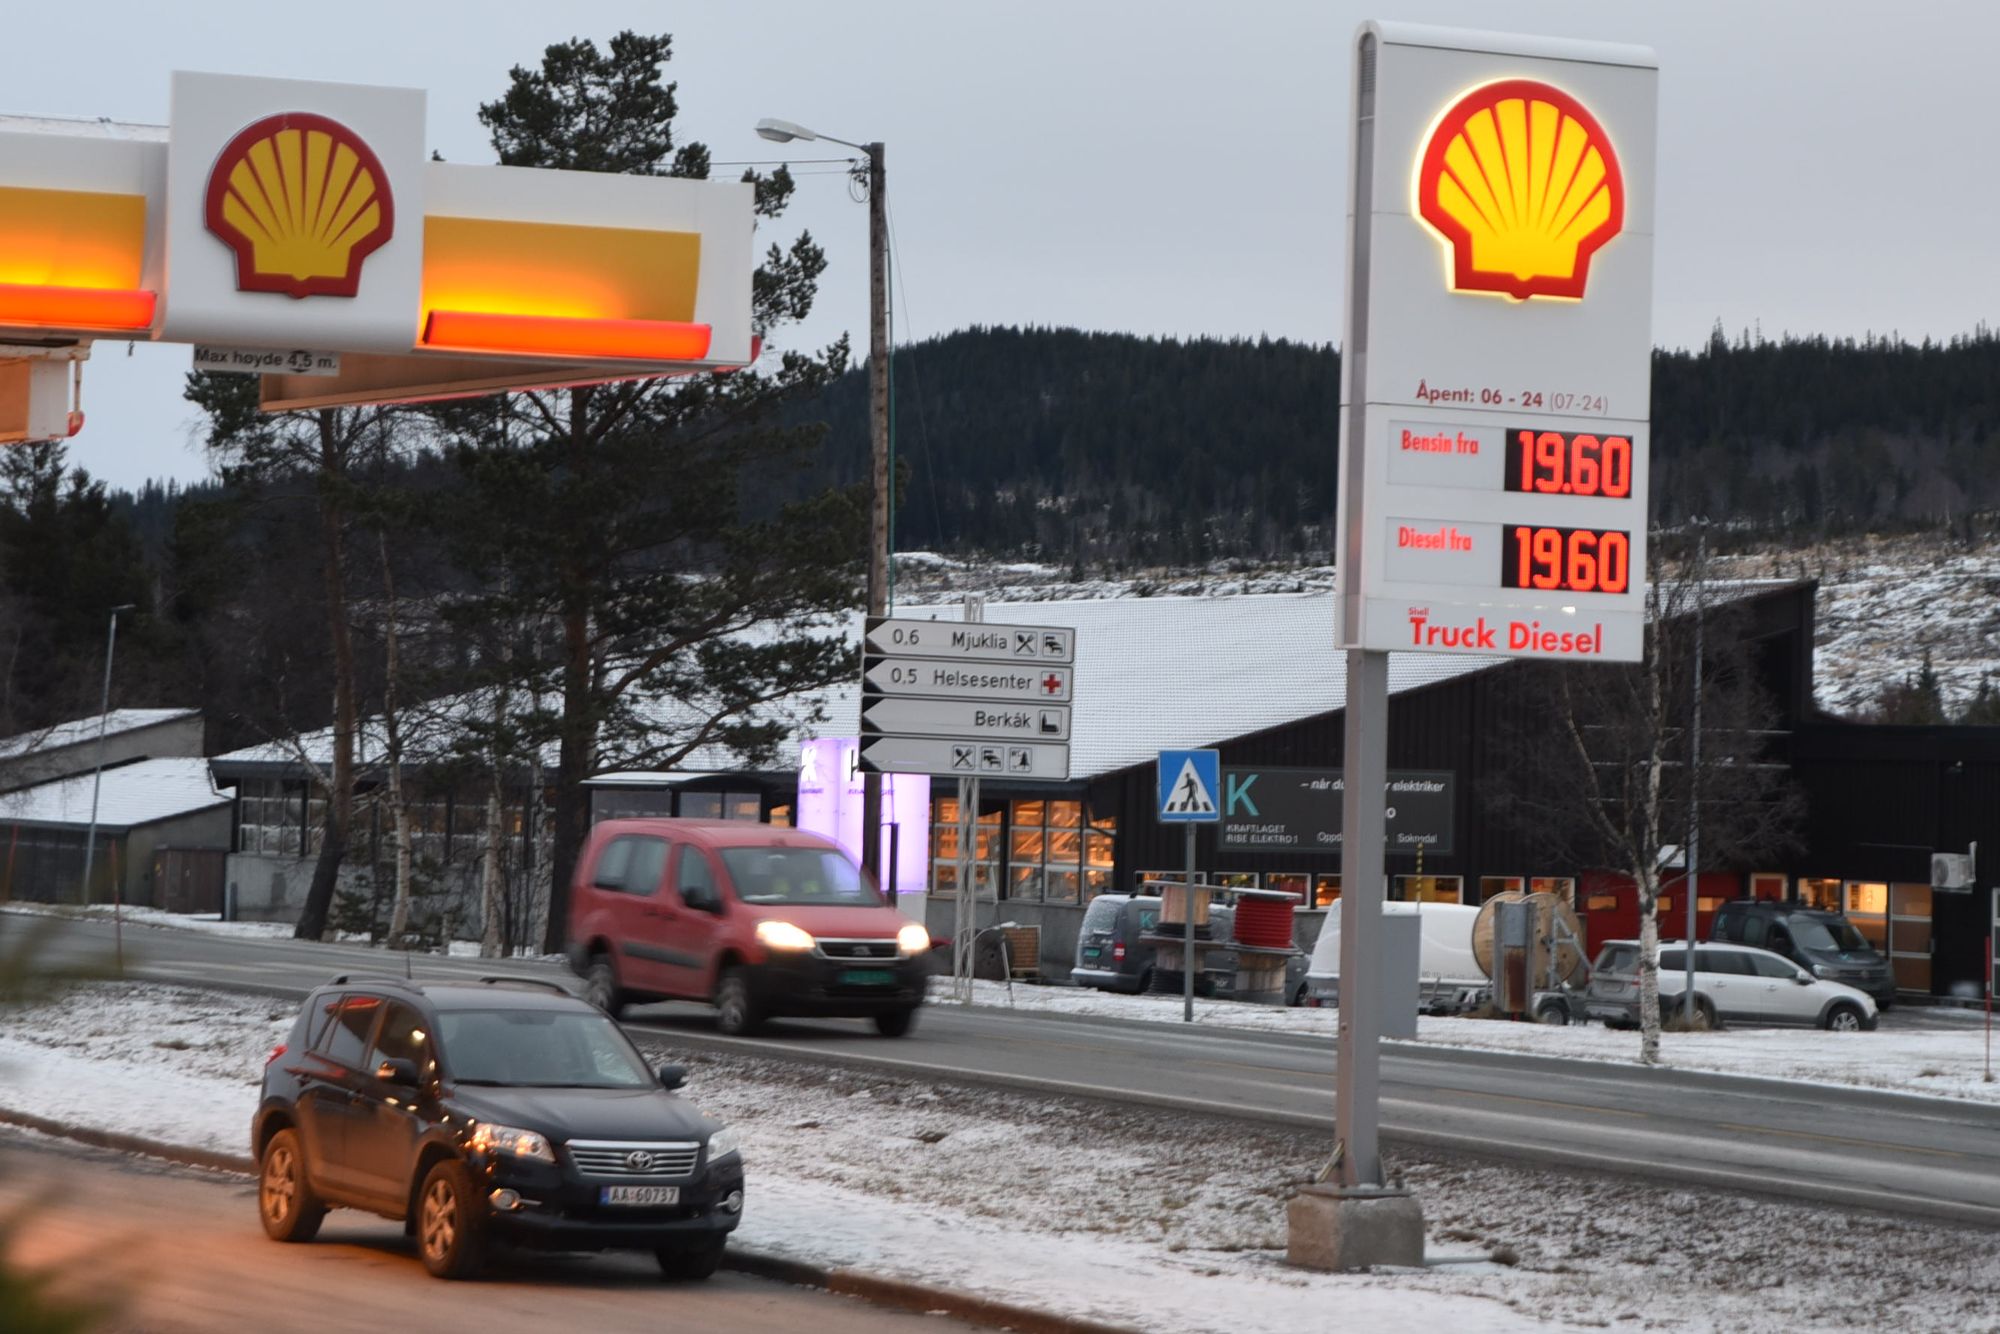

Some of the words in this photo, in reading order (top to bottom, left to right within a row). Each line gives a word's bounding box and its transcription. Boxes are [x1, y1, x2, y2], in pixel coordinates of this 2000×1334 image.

[195, 349, 228, 363] Max
[232, 351, 283, 368] høyde
[1416, 379, 1474, 404] Åpent:
[1481, 388, 1502, 405] 06
[1522, 391, 1543, 407] 24
[1550, 392, 1608, 415] (07-24)
[1401, 429, 1451, 454] Bensin
[1456, 432, 1479, 455] fra
[1518, 430, 1632, 497] 19.60
[1397, 526, 1446, 550] Diesel
[1450, 527, 1472, 551] fra
[951, 630, 1008, 652] Mjuklia
[1409, 616, 1497, 649] Truck
[1509, 621, 1603, 654] Diesel
[933, 668, 1034, 690] Helsesenter
[1226, 773, 1260, 817] K
[1391, 779, 1446, 793] elektriker
[611, 1187, 630, 1202] AA
[636, 1187, 677, 1202] 60737
